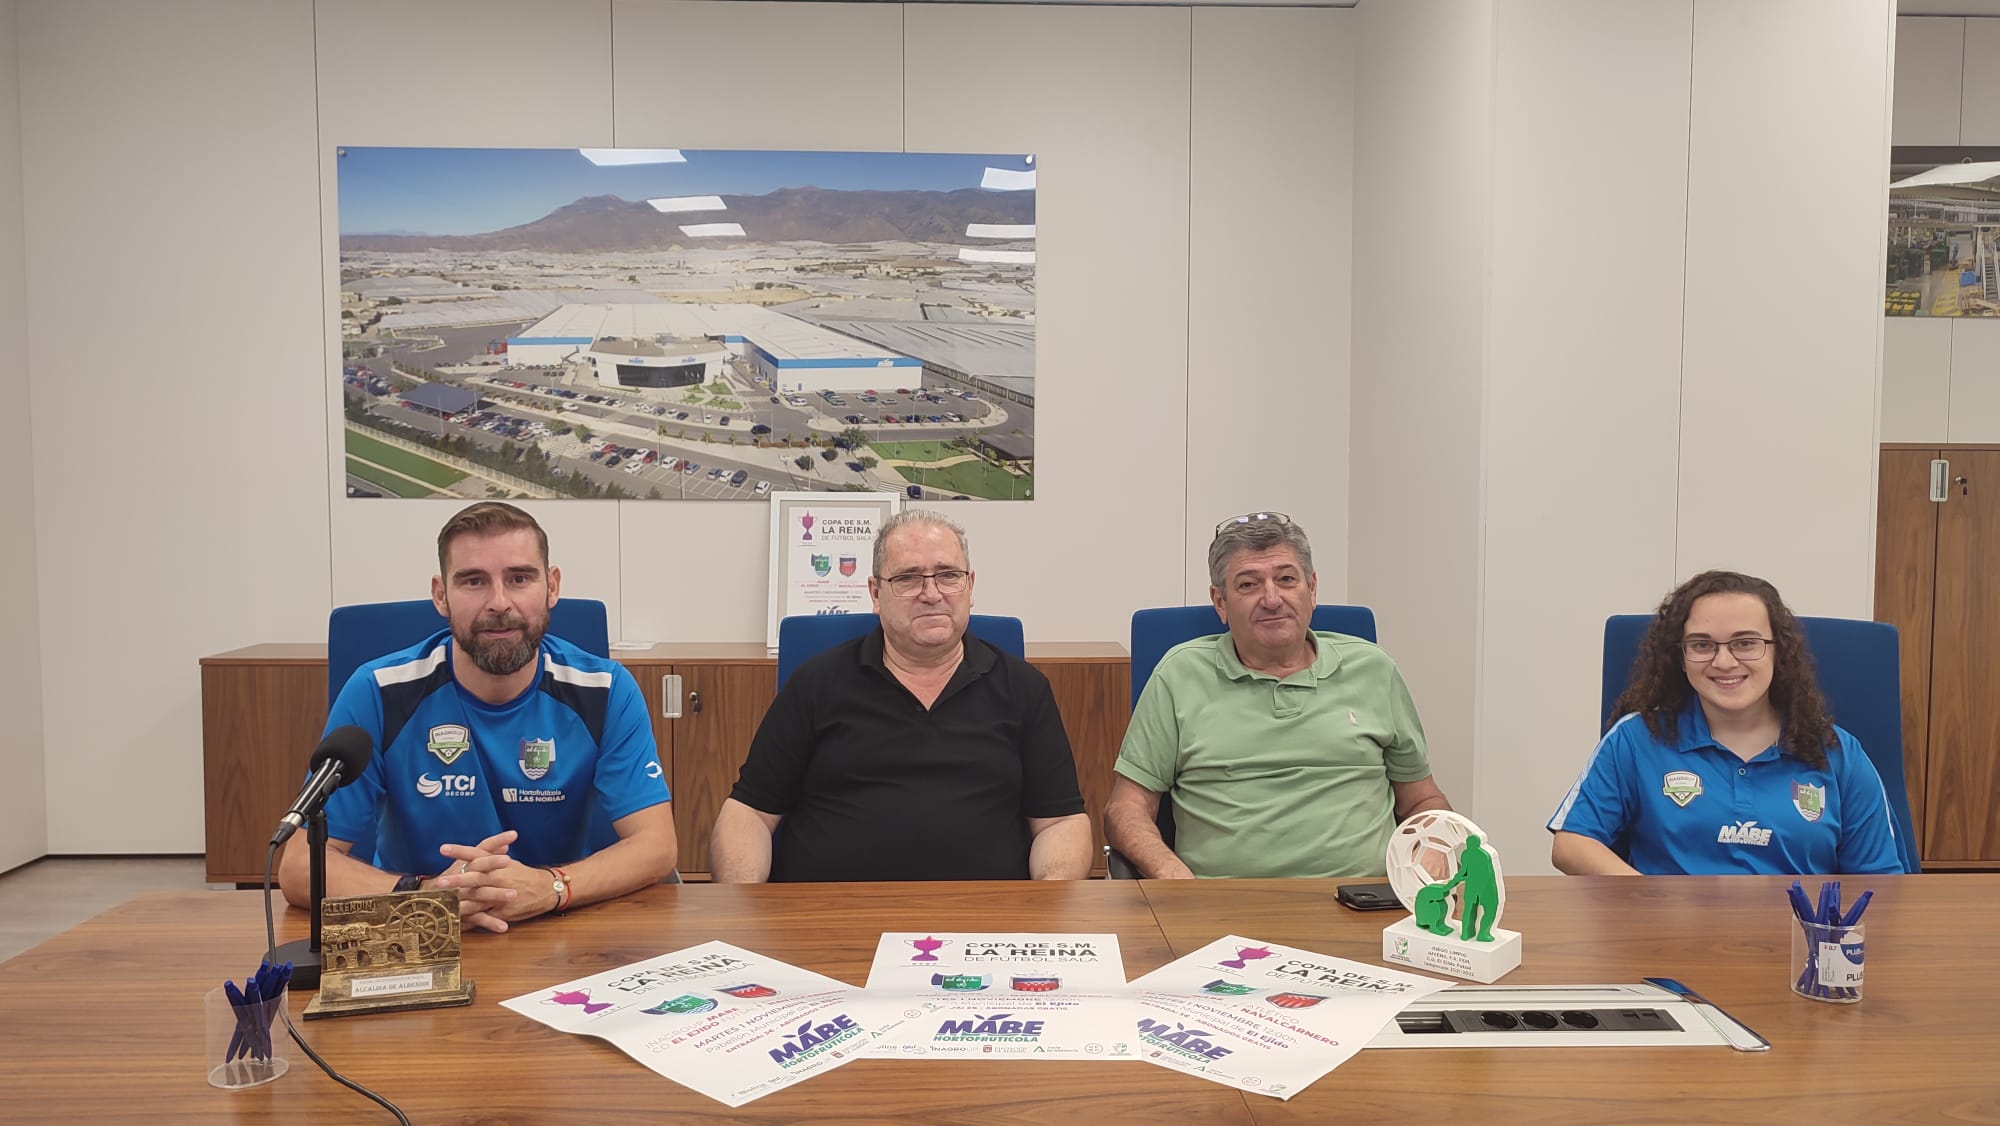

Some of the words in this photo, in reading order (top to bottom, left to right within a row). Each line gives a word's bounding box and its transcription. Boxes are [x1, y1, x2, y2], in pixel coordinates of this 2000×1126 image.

[822, 526, 835, 534] LA
[839, 526, 872, 534] REINA
[442, 775, 476, 791] TCI
[537, 794, 565, 802] NORIAS
[1719, 826, 1772, 841] MABE
[608, 969, 657, 988] COPA
[660, 962, 682, 972] DE
[618, 977, 658, 992] LA
[660, 958, 742, 980] REINA
[1265, 972, 1288, 980] DE
[1275, 965, 1309, 978] LA
[1318, 974, 1406, 992] REINA
[1288, 960, 1336, 974] COPA
[1343, 972, 1368, 981] DE
[634, 984, 658, 995] DE
[1194, 1003, 1263, 1030] NOVIEMBRE
[1240, 1008, 1340, 1046] NAVALCARNERO
[694, 1028, 740, 1048] MARTES
[1260, 1034, 1289, 1048] Ejido
